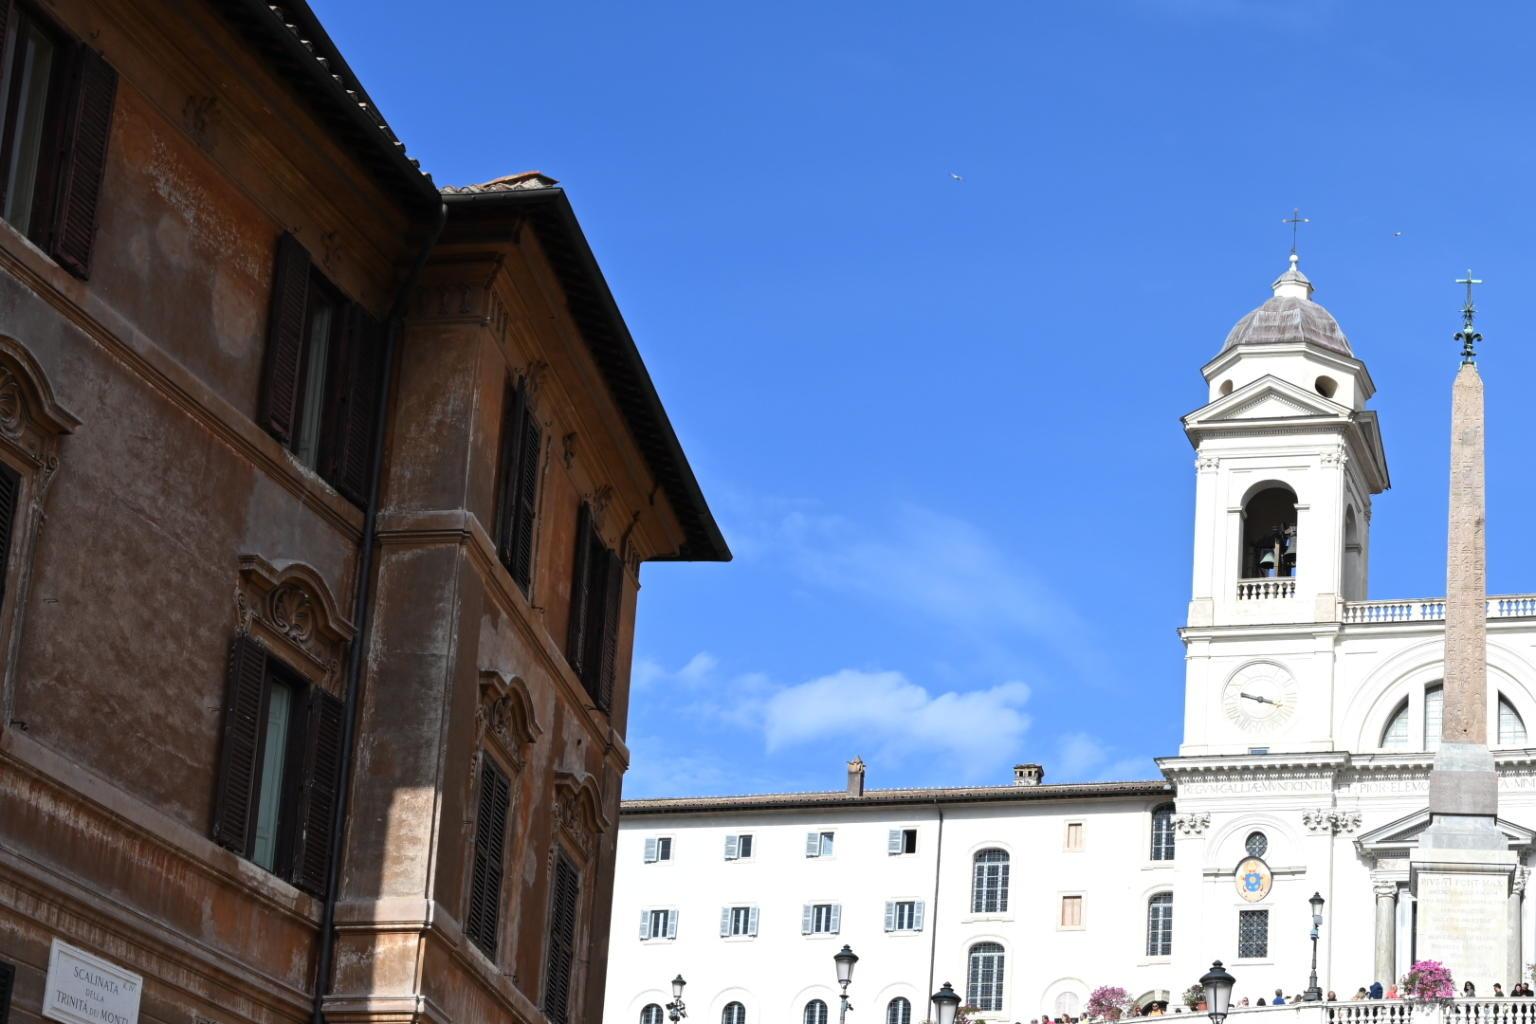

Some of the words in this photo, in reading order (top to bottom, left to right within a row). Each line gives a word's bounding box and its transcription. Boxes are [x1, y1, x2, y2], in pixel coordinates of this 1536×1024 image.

[74, 967, 118, 995] SCALINATA
[86, 989, 104, 1002] DELLA
[89, 1008, 100, 1018] DEI
